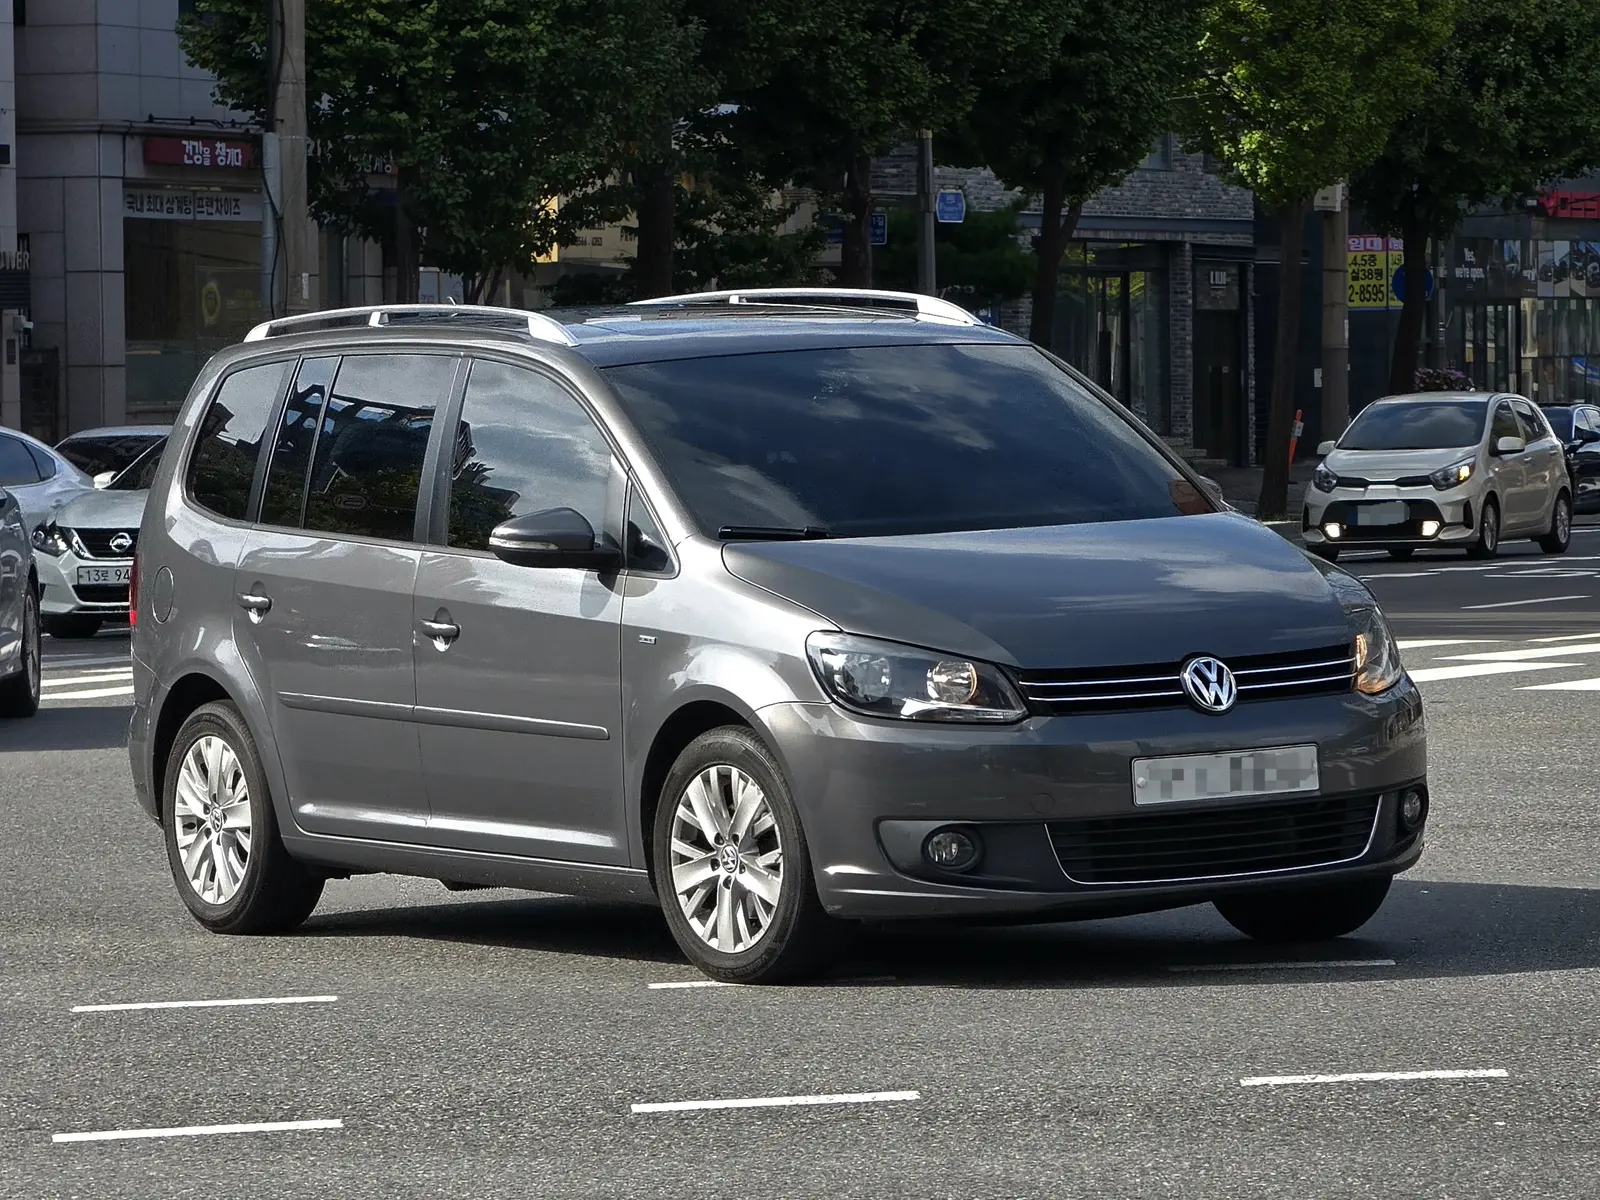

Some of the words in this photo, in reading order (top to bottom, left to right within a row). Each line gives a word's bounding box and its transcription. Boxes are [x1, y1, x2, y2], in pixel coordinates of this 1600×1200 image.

[181, 140, 211, 165] 건강을
[215, 141, 242, 167] 챙기다
[126, 193, 144, 212] 국내
[146, 194, 164, 213] 최대
[165, 195, 192, 215] 삼계탕
[1348, 237, 1383, 251] 임대
[85, 569, 109, 582] 13로
[1187, 658, 1234, 708] VW
